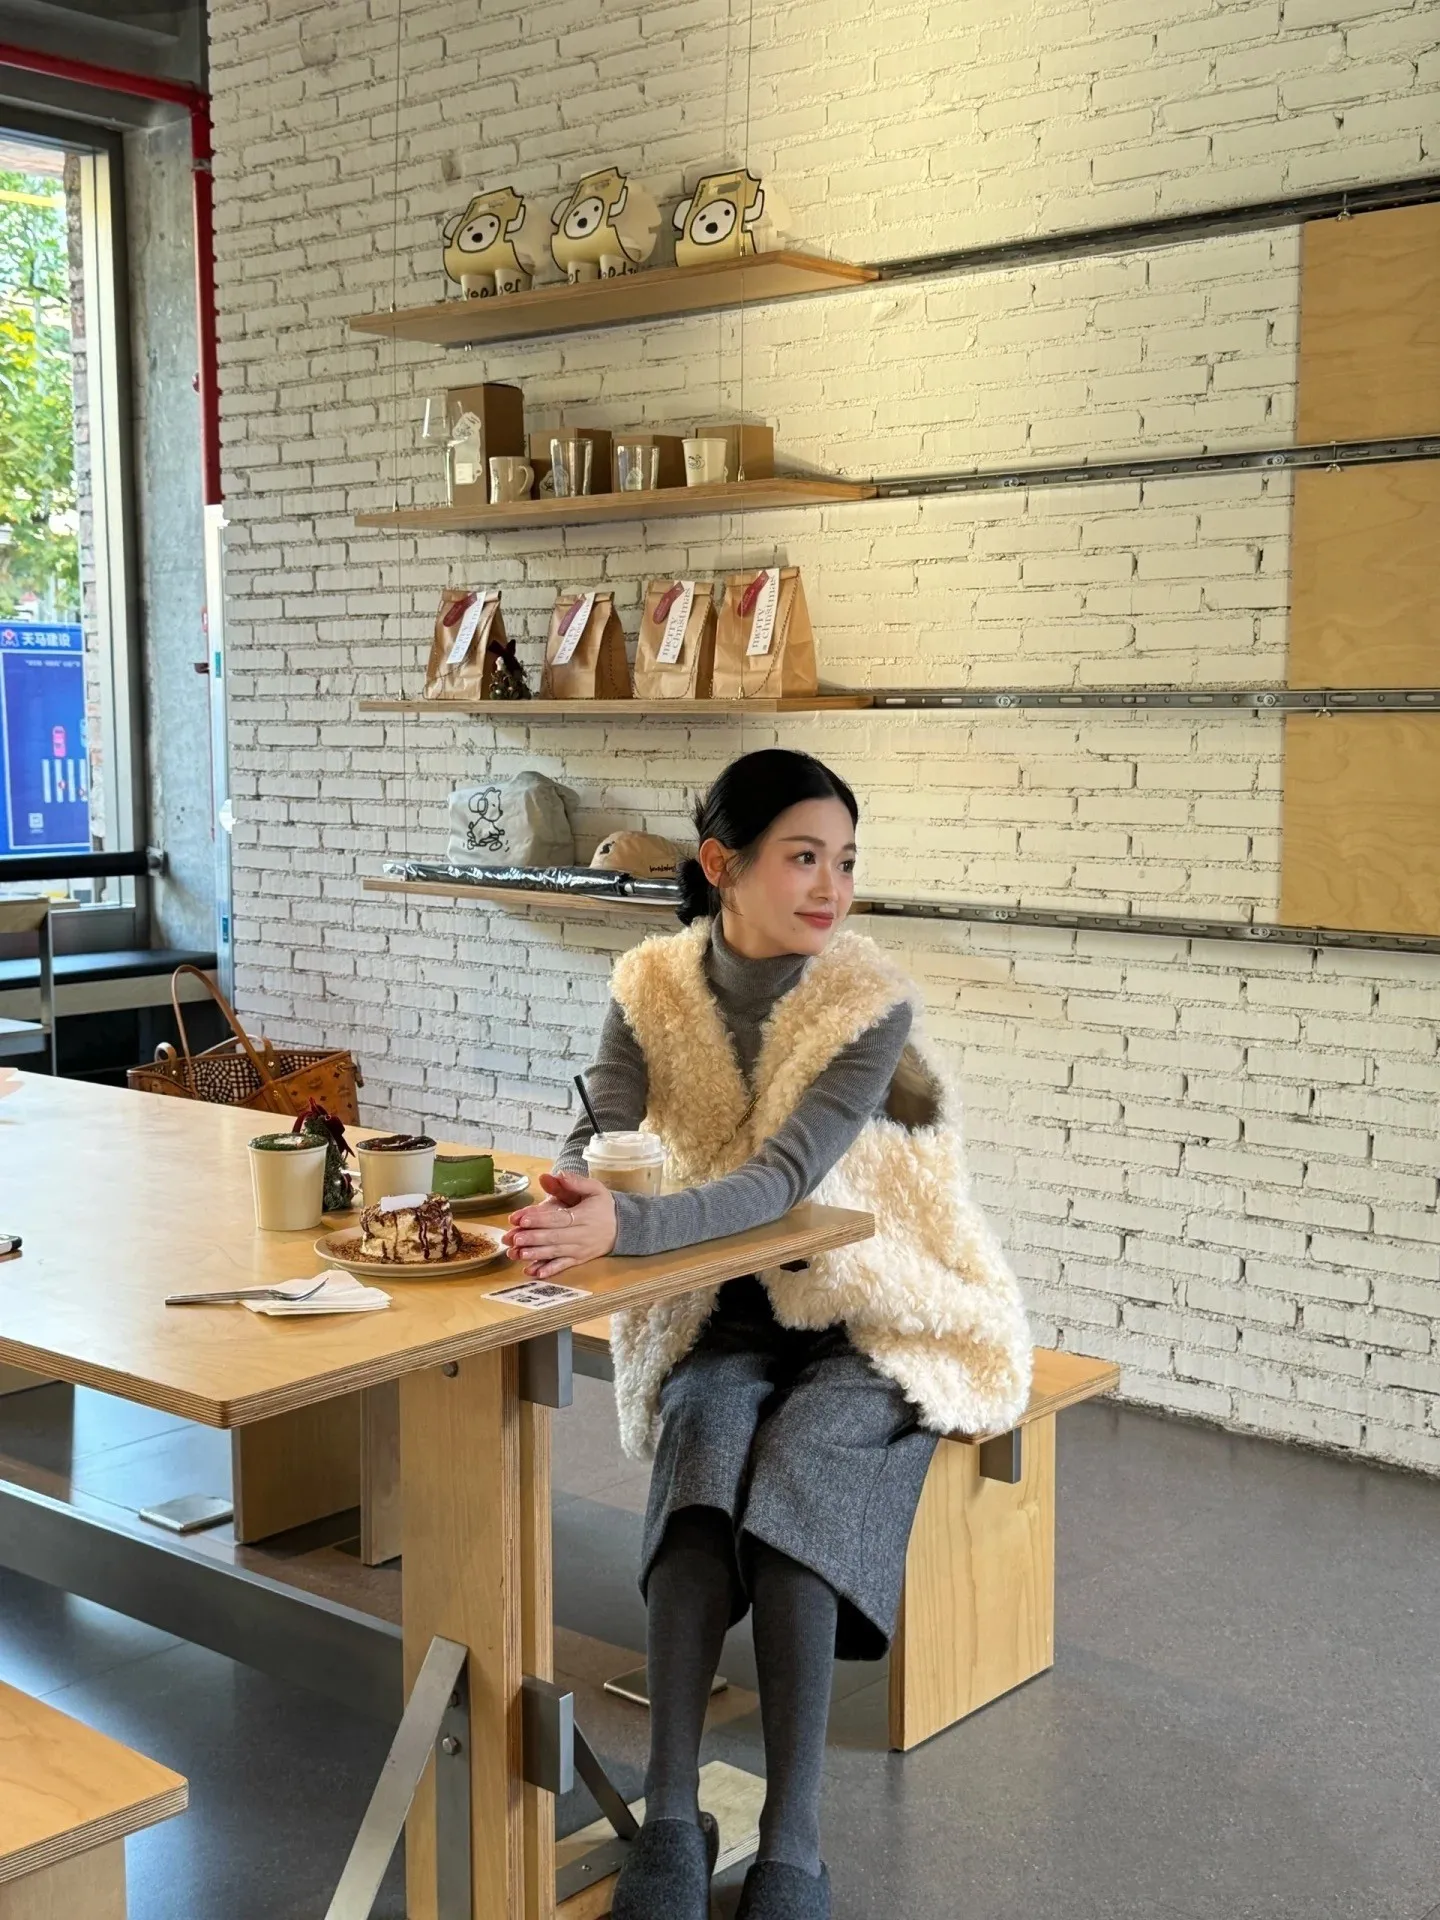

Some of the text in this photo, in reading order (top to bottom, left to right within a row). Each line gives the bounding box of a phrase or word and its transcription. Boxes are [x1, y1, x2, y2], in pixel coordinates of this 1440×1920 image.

[672, 587, 691, 649] christmas
[752, 608, 766, 648] merry
[761, 575, 776, 640] christmas
[662, 617, 678, 656] merry
